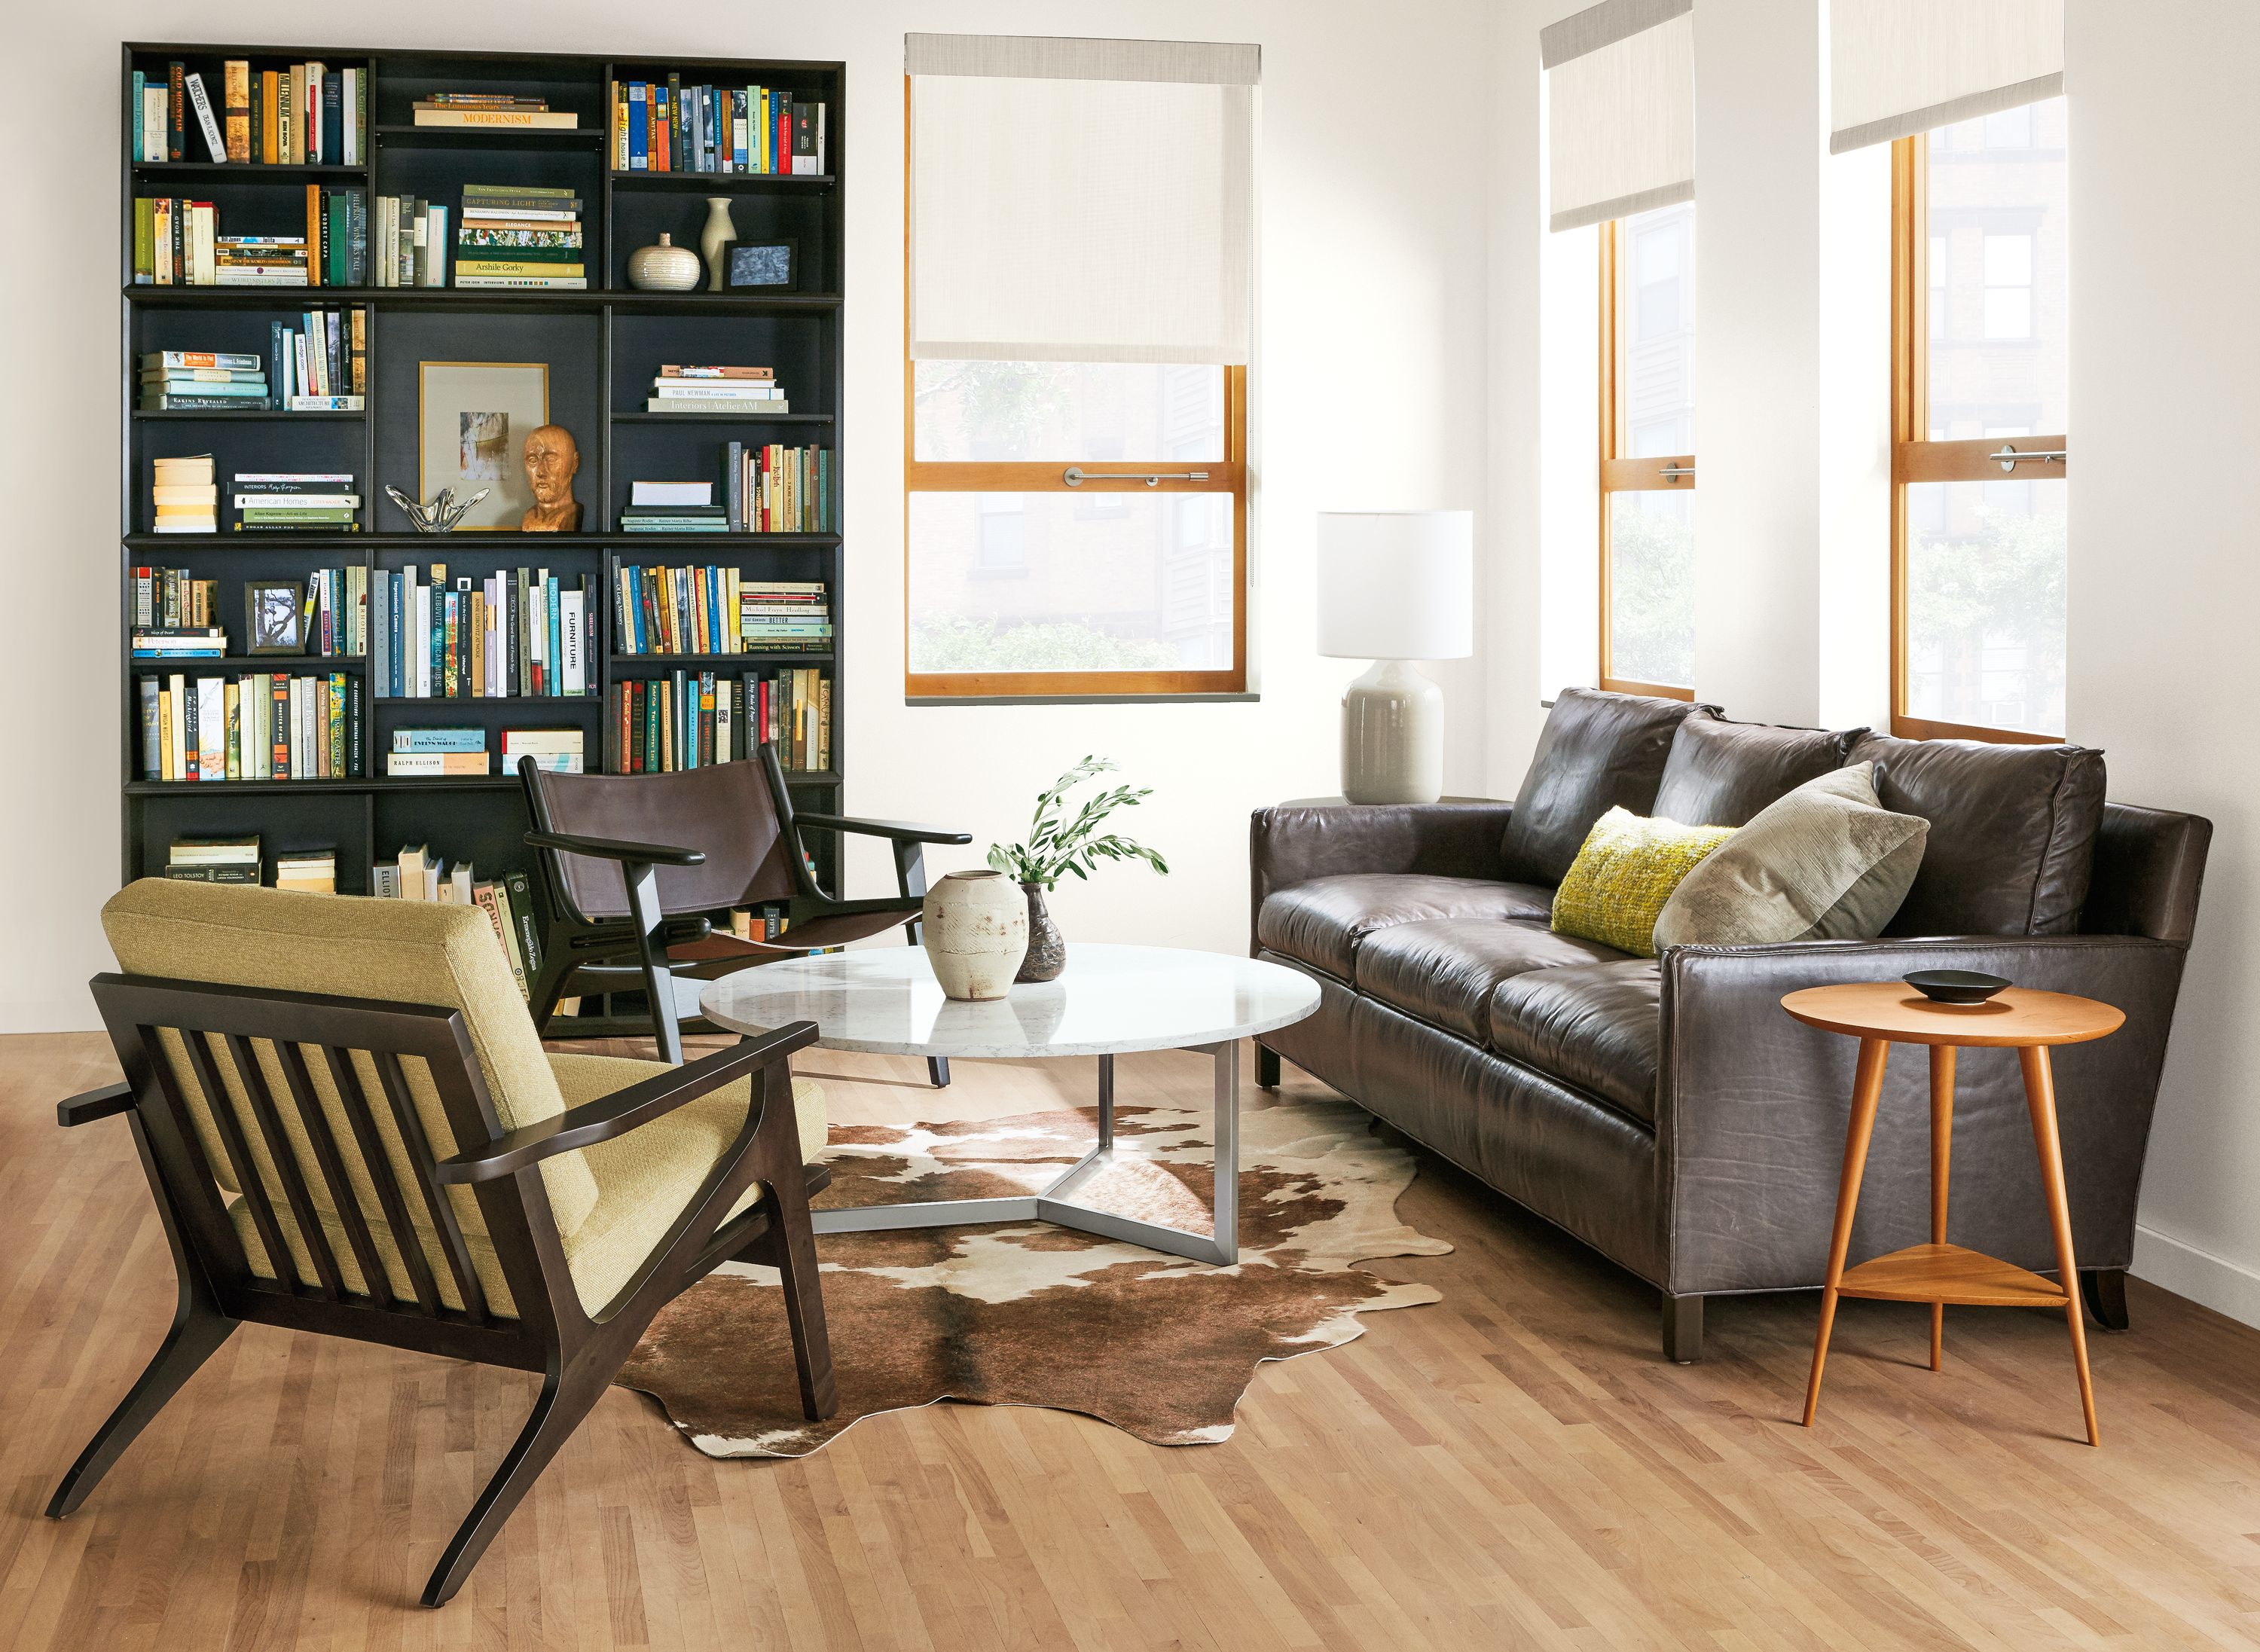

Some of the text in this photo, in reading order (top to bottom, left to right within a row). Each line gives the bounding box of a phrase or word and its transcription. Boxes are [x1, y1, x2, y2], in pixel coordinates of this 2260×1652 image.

[190, 79, 207, 110] WATCHERS
[280, 75, 289, 118] MILLENNIUM
[202, 115, 211, 127] DEAN
[463, 113, 531, 124] MODERNISM
[502, 264, 524, 273] Gorky
[671, 401, 706, 409] Interiors
[712, 402, 741, 410] Atelier
[249, 497, 280, 505] American
[194, 696, 197, 704] TO
[305, 678, 313, 735] Walker Evans
[522, 915, 534, 953] Ermenegildo
